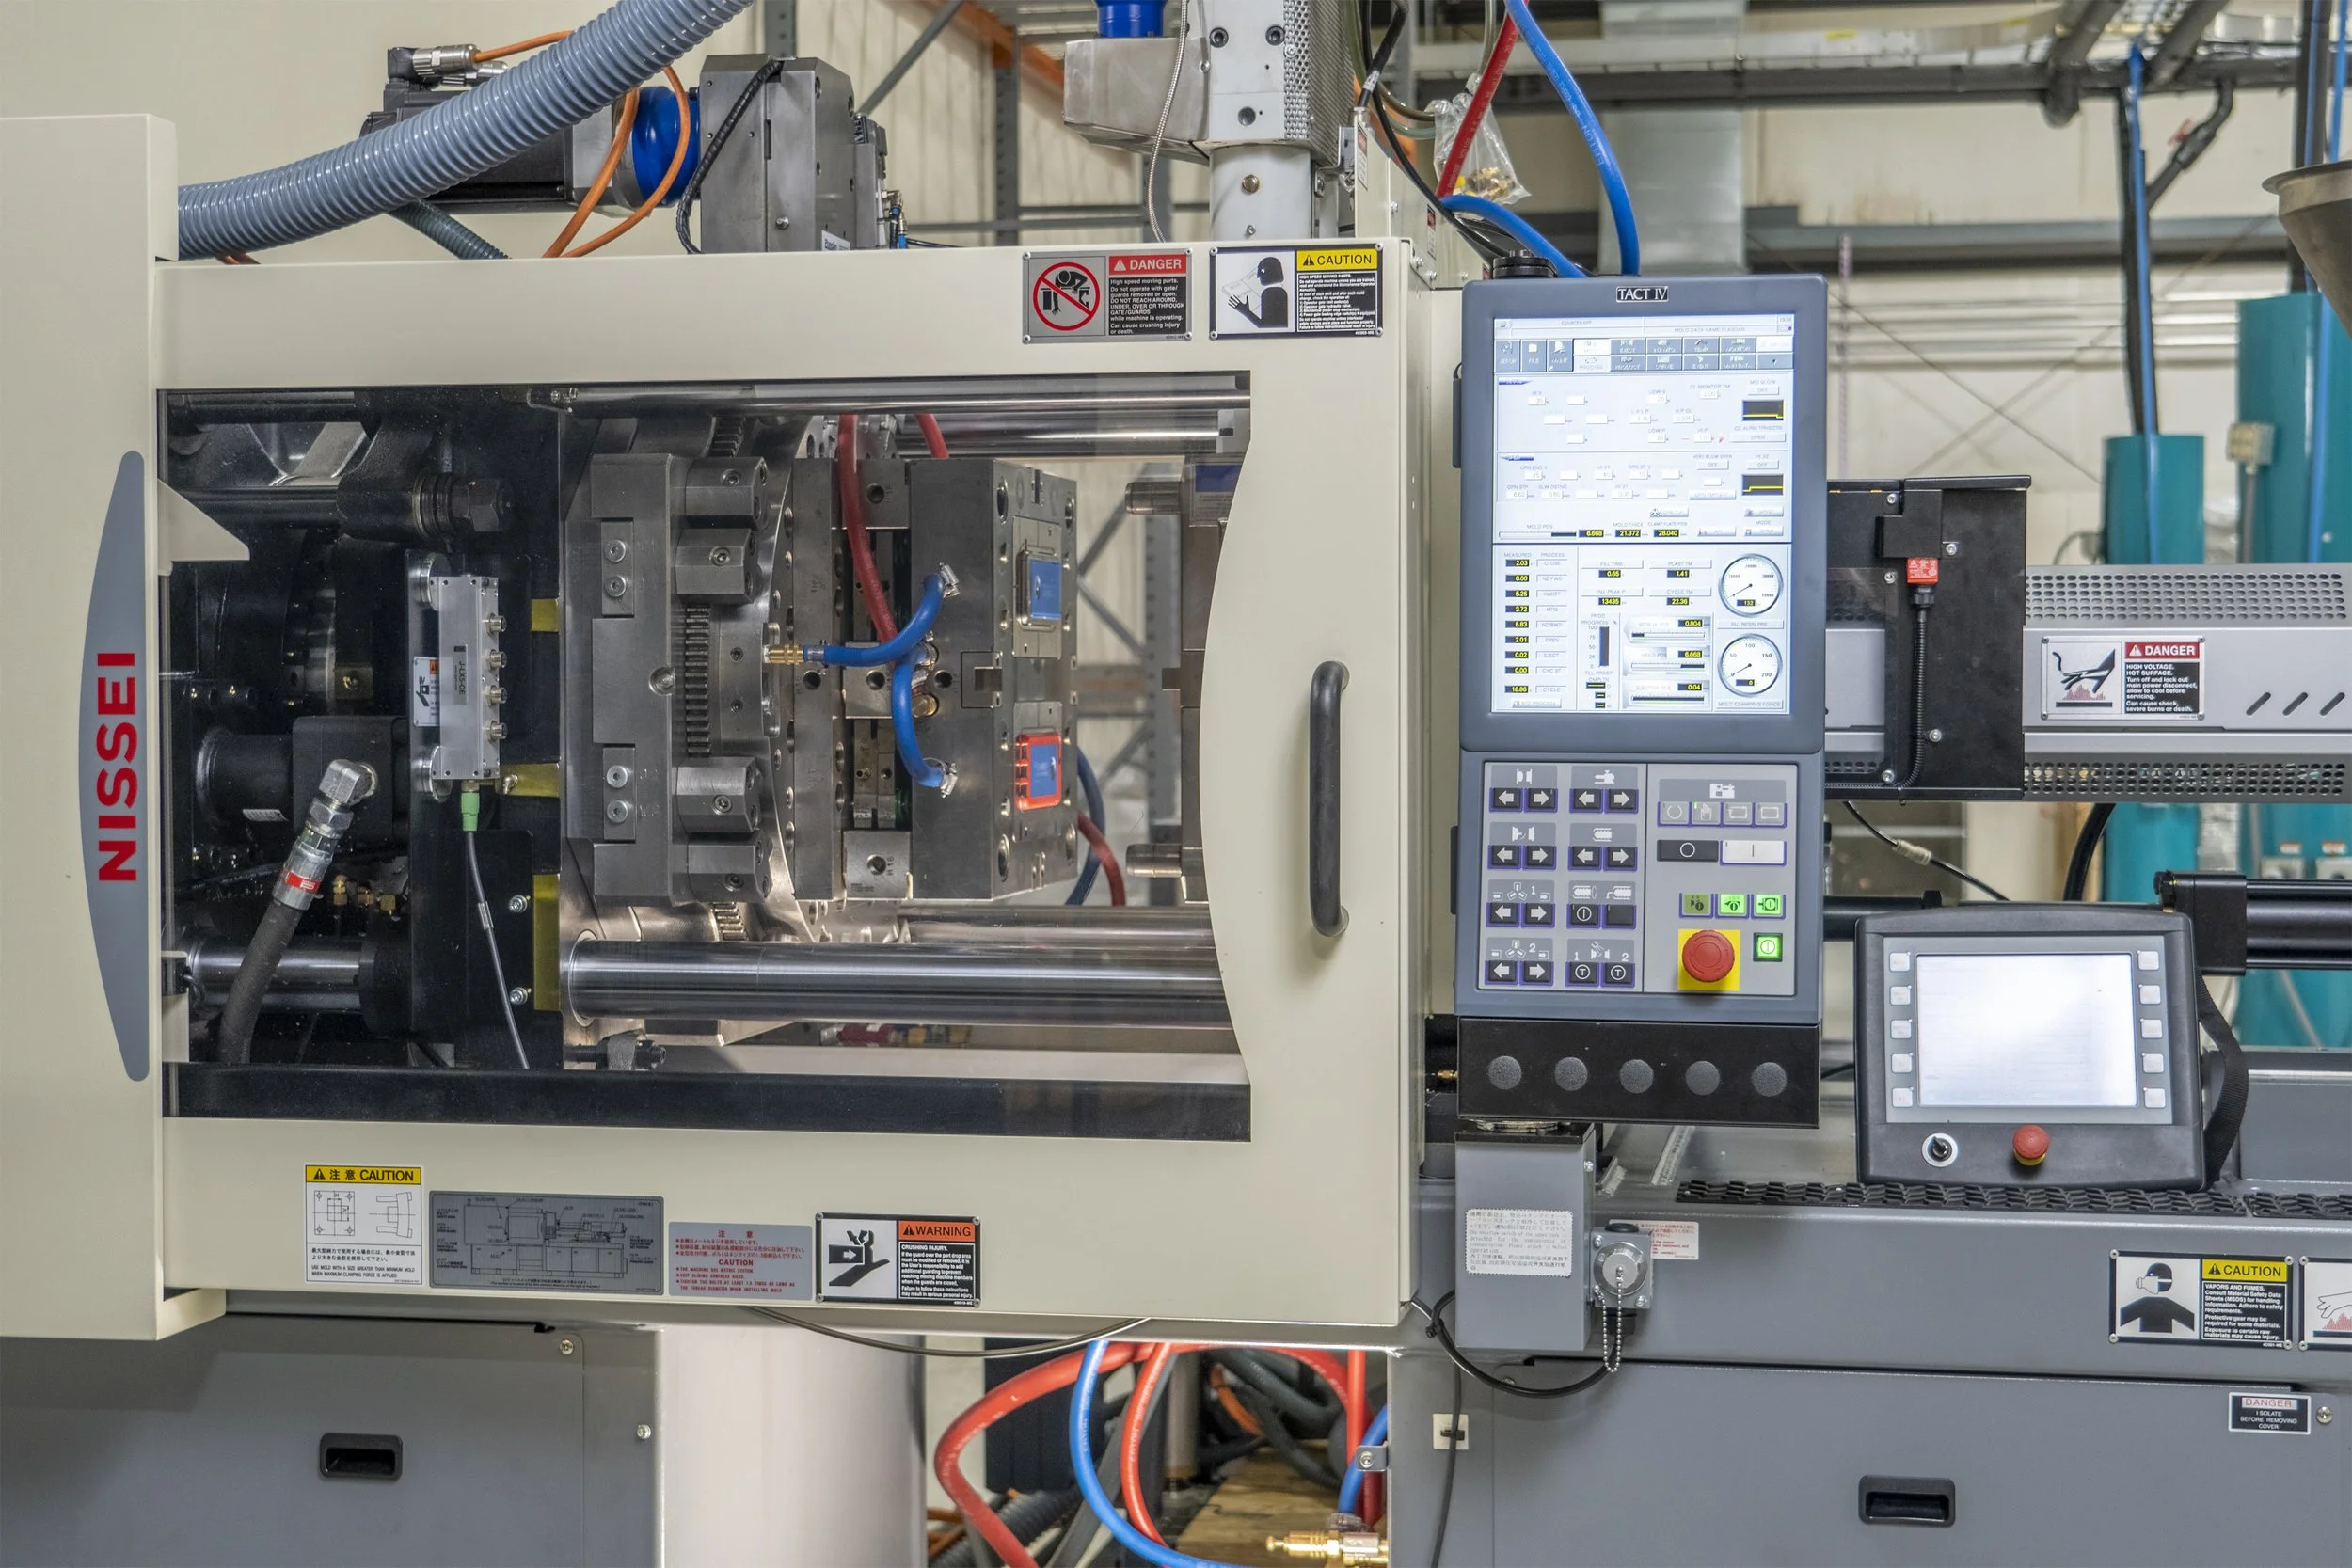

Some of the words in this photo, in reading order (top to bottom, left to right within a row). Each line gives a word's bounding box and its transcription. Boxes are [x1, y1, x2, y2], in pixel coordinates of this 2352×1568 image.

[1130, 259, 1181, 270] DANGER
[1317, 254, 1371, 265] CAUTION
[1618, 287, 1651, 301] TACT
[1654, 287, 1668, 300] IV
[2145, 646, 2195, 655] DANGER
[96, 652, 139, 881] NISSEI
[1531, 886, 1536, 895] 1
[1529, 944, 1536, 952] 2
[1574, 951, 1579, 961] 1
[1622, 953, 1629, 961] 2
[360, 1170, 413, 1181] CAUTION
[916, 1226, 971, 1236] WARNING
[2224, 1265, 2281, 1276] CAUTION
[2245, 1399, 2292, 1407] DANGER
